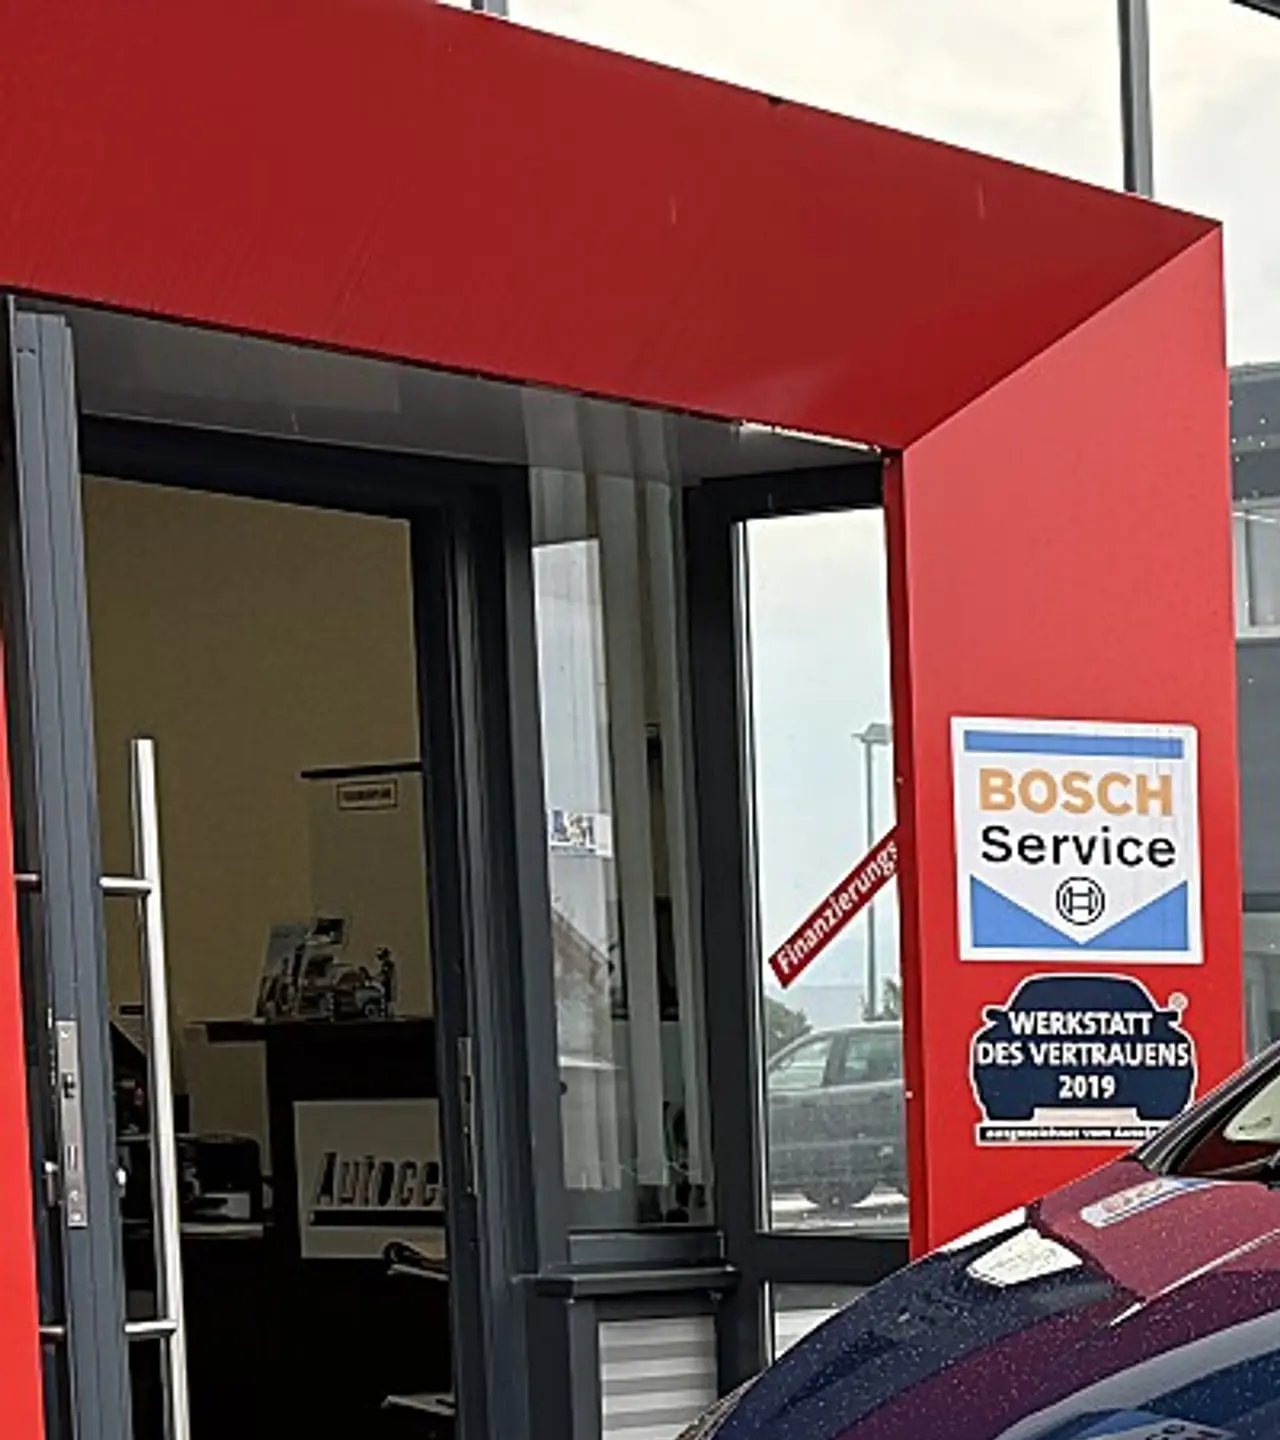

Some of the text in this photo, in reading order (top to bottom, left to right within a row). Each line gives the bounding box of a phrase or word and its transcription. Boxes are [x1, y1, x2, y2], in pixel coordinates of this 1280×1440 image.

[977, 766, 1174, 818] BOSCH
[981, 825, 1177, 869] Service
[1008, 1011, 1154, 1035] WERKSTATT
[977, 1042, 1189, 1067] DES VERTRAUENS
[1058, 1075, 1117, 1099] 2019
